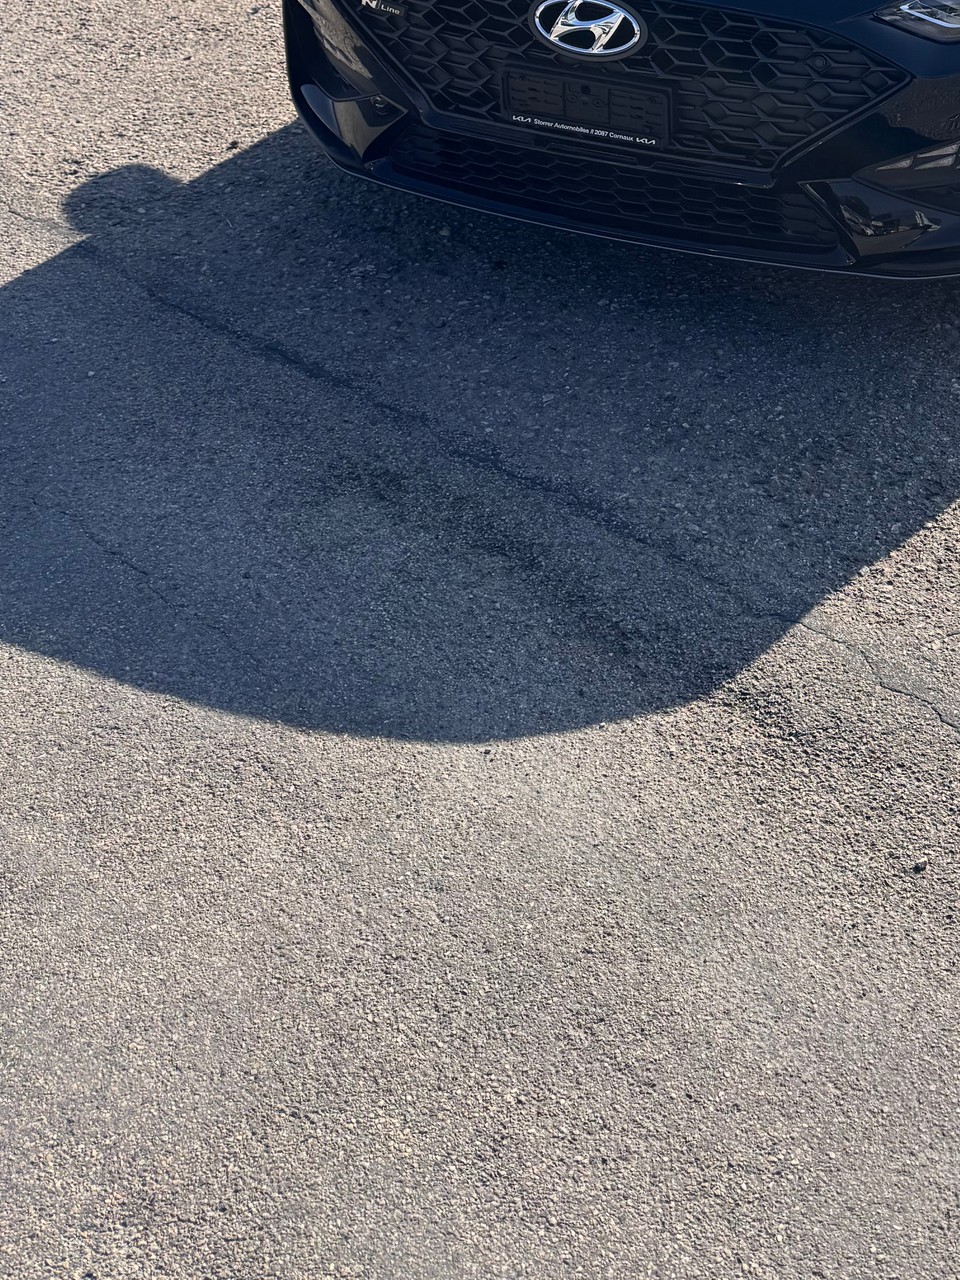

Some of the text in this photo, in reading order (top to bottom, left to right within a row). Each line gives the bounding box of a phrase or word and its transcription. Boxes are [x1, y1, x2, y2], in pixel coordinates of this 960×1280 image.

[381, 4, 400, 15] Line
[512, 115, 532, 123] KIA
[533, 118, 554, 127] Storrer
[553, 122, 590, 134] Automobiles
[608, 131, 634, 142] Cornaux
[636, 137, 656, 145] KIA
